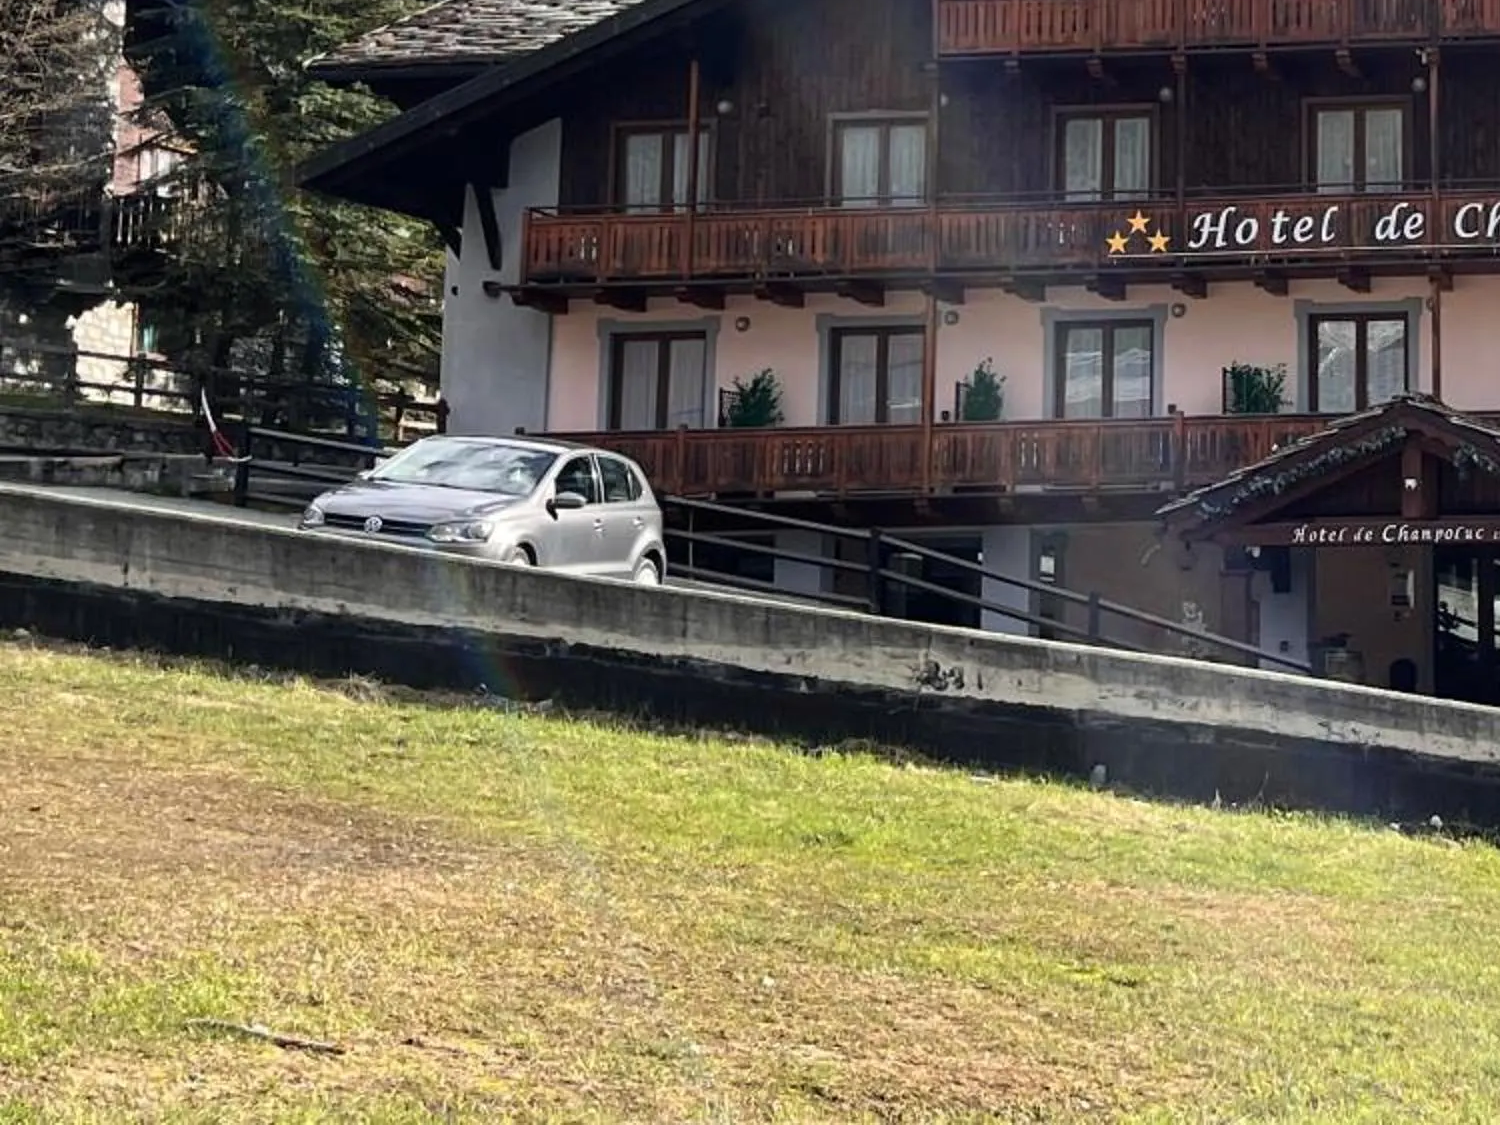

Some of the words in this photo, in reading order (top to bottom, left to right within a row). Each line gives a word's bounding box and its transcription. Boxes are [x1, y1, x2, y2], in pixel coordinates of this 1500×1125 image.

[1187, 206, 1338, 249] Hotel
[1374, 202, 1424, 241] de
[1292, 524, 1347, 543] Hotel
[1353, 527, 1373, 542] de
